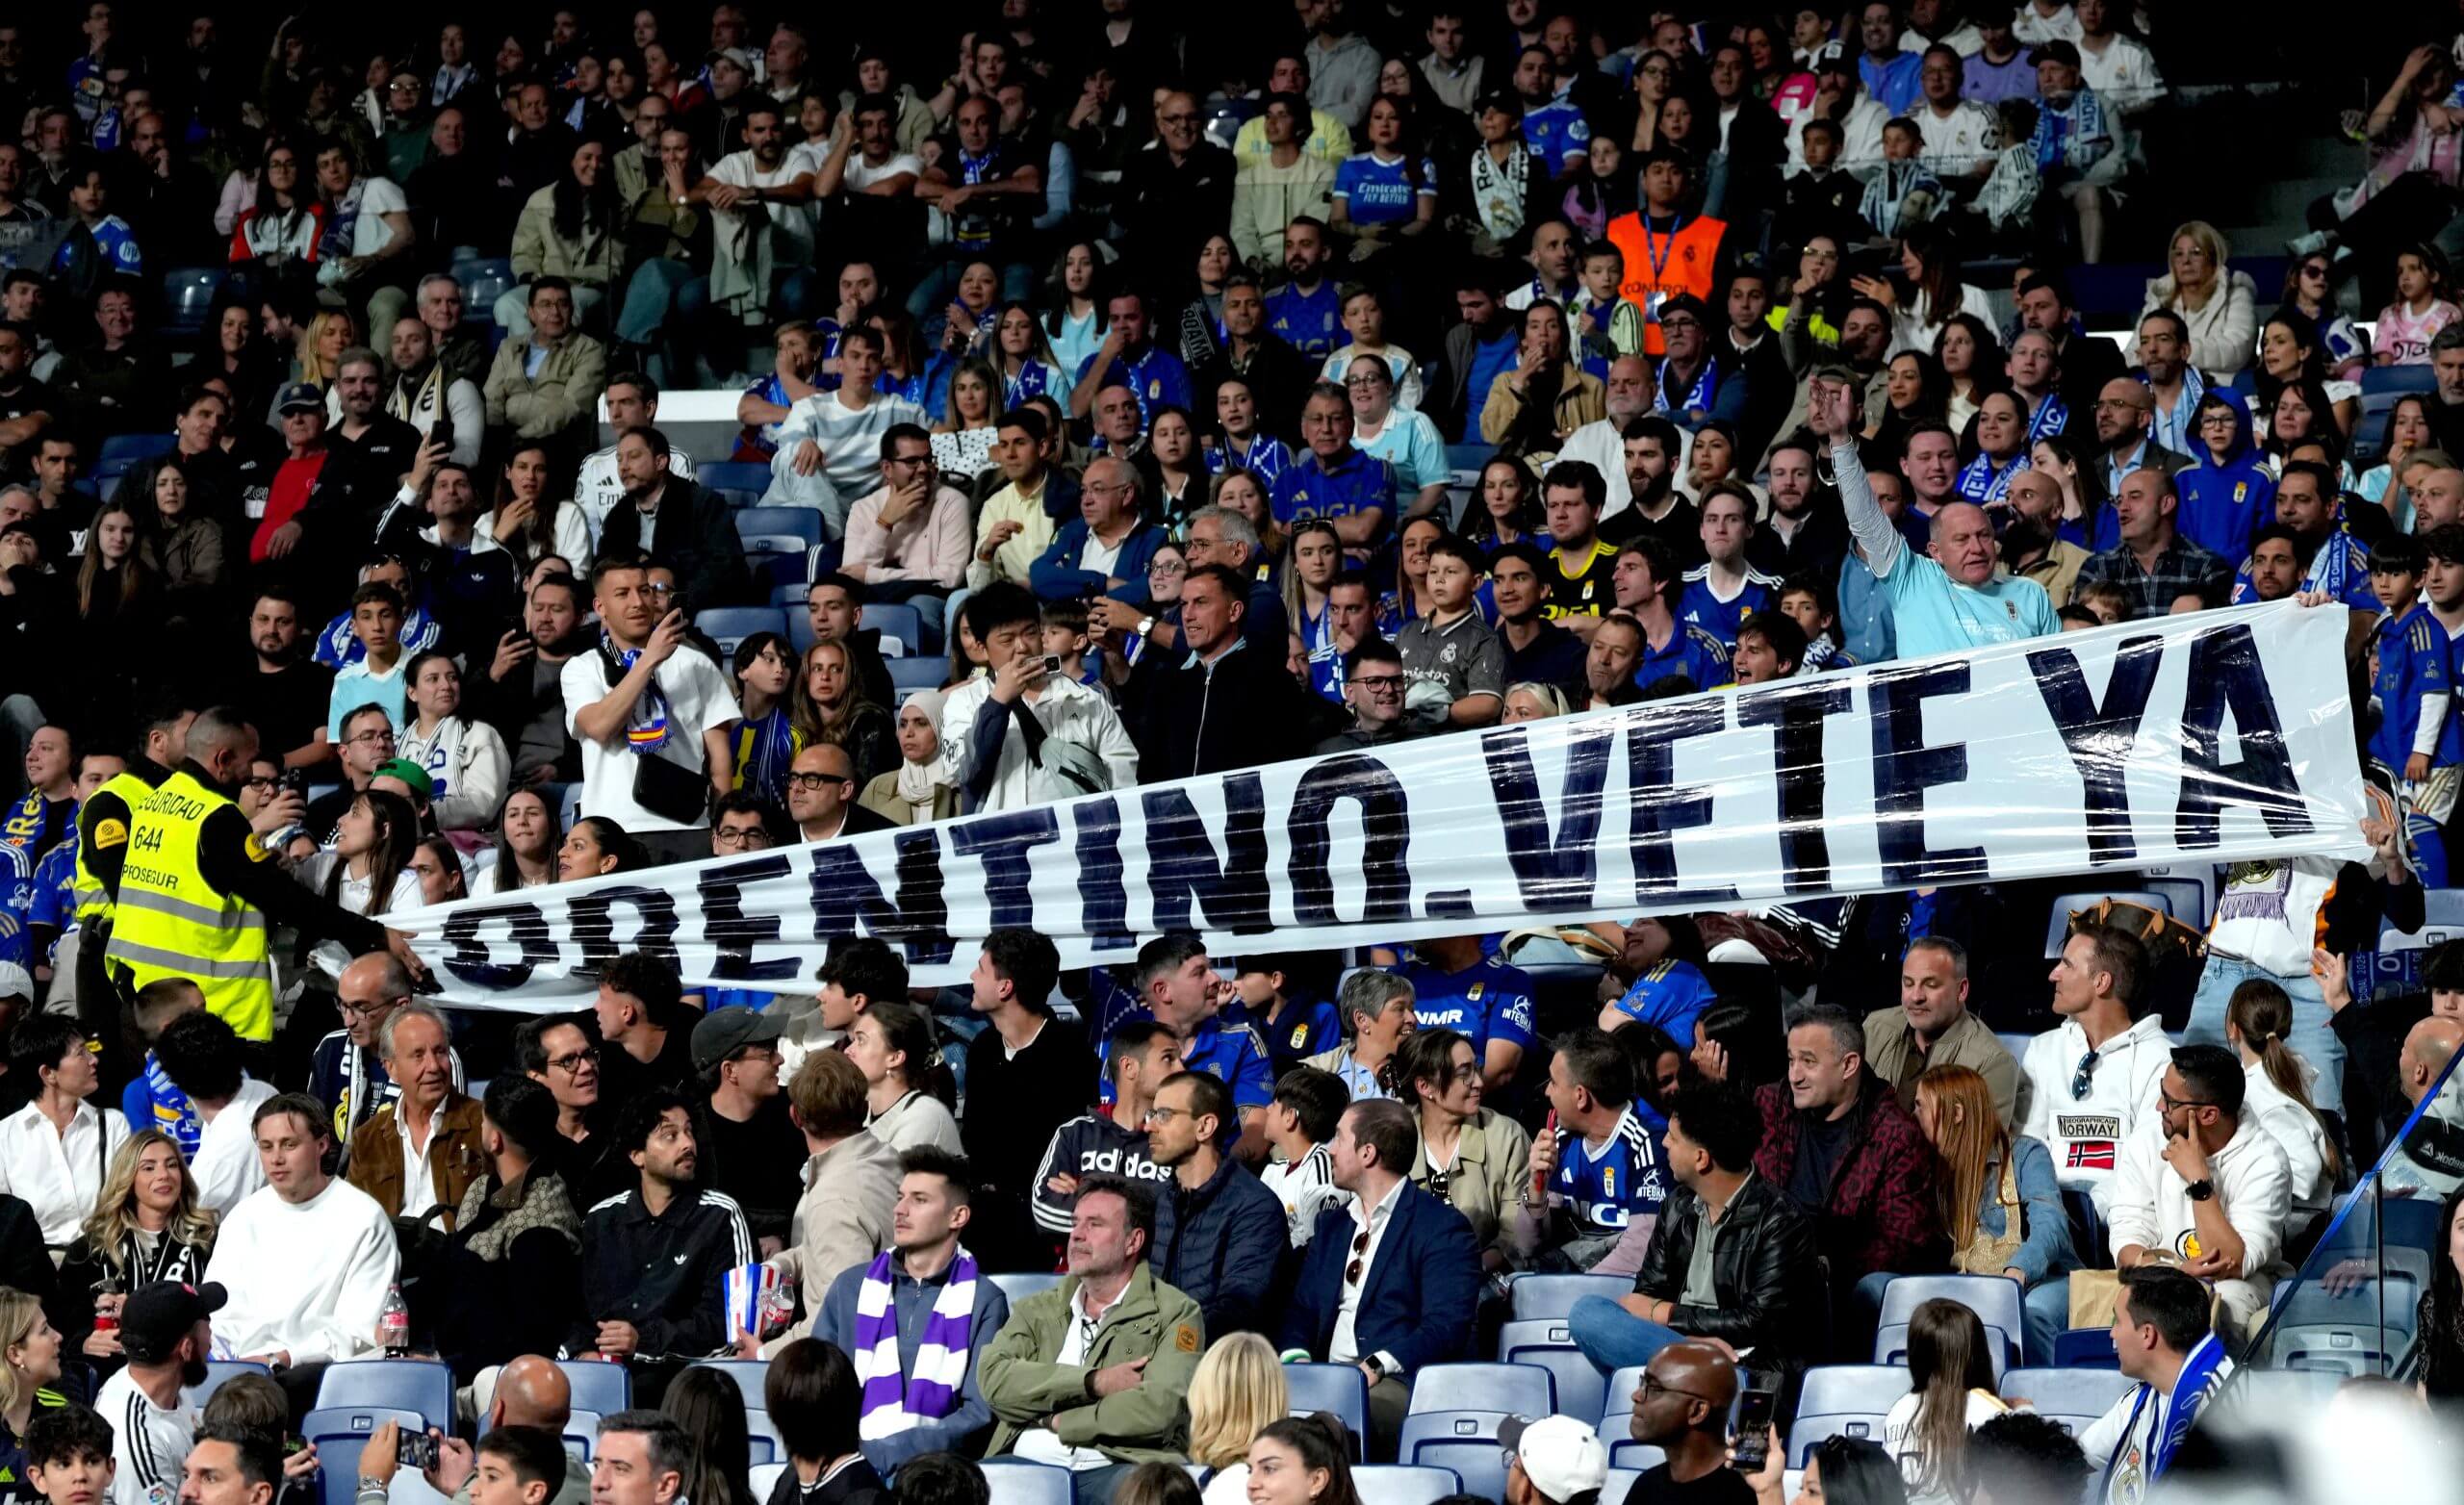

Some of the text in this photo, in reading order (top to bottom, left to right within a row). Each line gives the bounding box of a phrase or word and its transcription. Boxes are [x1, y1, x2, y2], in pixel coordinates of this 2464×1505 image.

[1624, 280, 1688, 295] CONROL
[2025, 623, 2317, 866] YA
[139, 789, 205, 821] GURIDAD
[134, 825, 165, 854] 644
[2057, 1117, 2115, 1136] NORWAY
